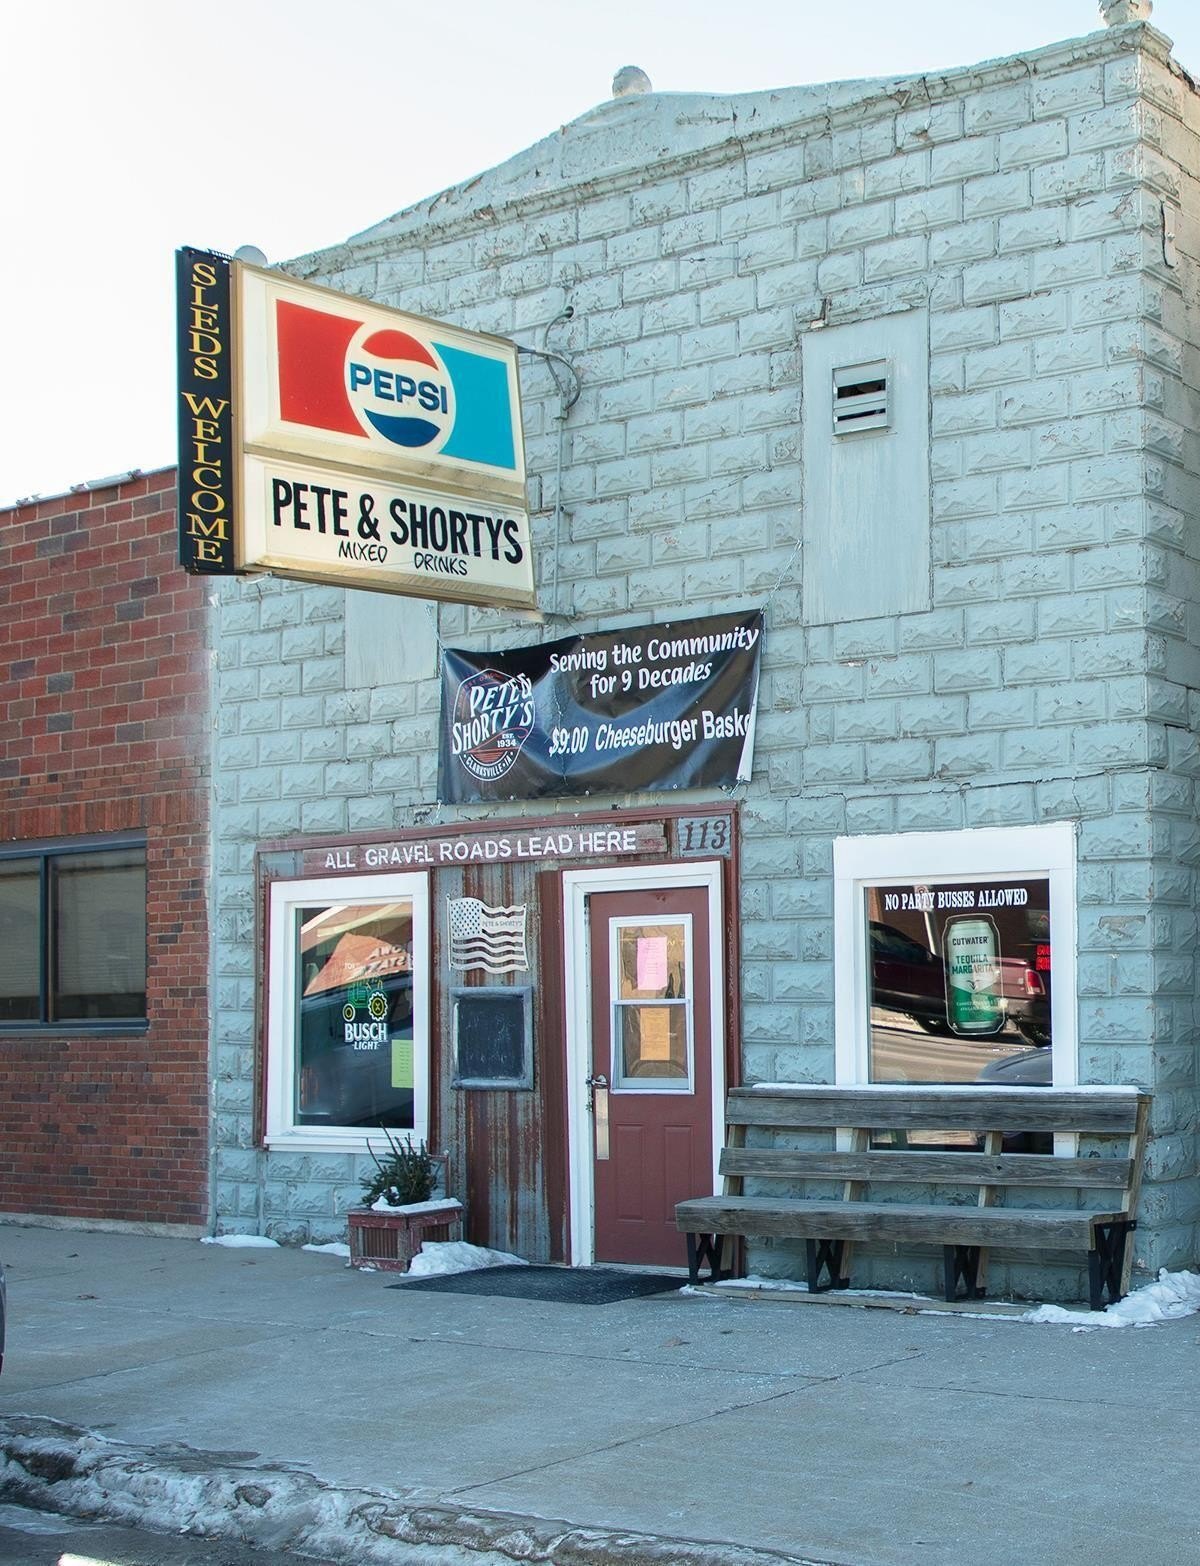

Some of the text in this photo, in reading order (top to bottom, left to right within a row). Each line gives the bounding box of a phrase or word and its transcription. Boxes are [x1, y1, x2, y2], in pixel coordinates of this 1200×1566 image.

[189, 262, 222, 380] SLEDS
[349, 362, 448, 415] PEPSI
[182, 392, 230, 564] WELCOME
[272, 478, 523, 565] PETE & SHORTYS
[338, 540, 468, 576] MIXED DRINKS
[549, 626, 759, 673] Serving the Community
[590, 661, 712, 698] for 9 Decades
[452, 701, 535, 755] SHORTY'S
[497, 739, 517, 748] 1934
[548, 725, 589, 757] $9.00
[595, 717, 698, 751] Cheeseburger
[325, 830, 636, 869] ALL GRAVEL ROADS LEAD HERE
[682, 819, 727, 851] 113
[885, 888, 1028, 910] NO PARTY BUSSES ALLOWED
[952, 936, 988, 946] CUTWATER
[956, 953, 989, 965] TEQUILA
[344, 1022, 388, 1043] BUSCH
